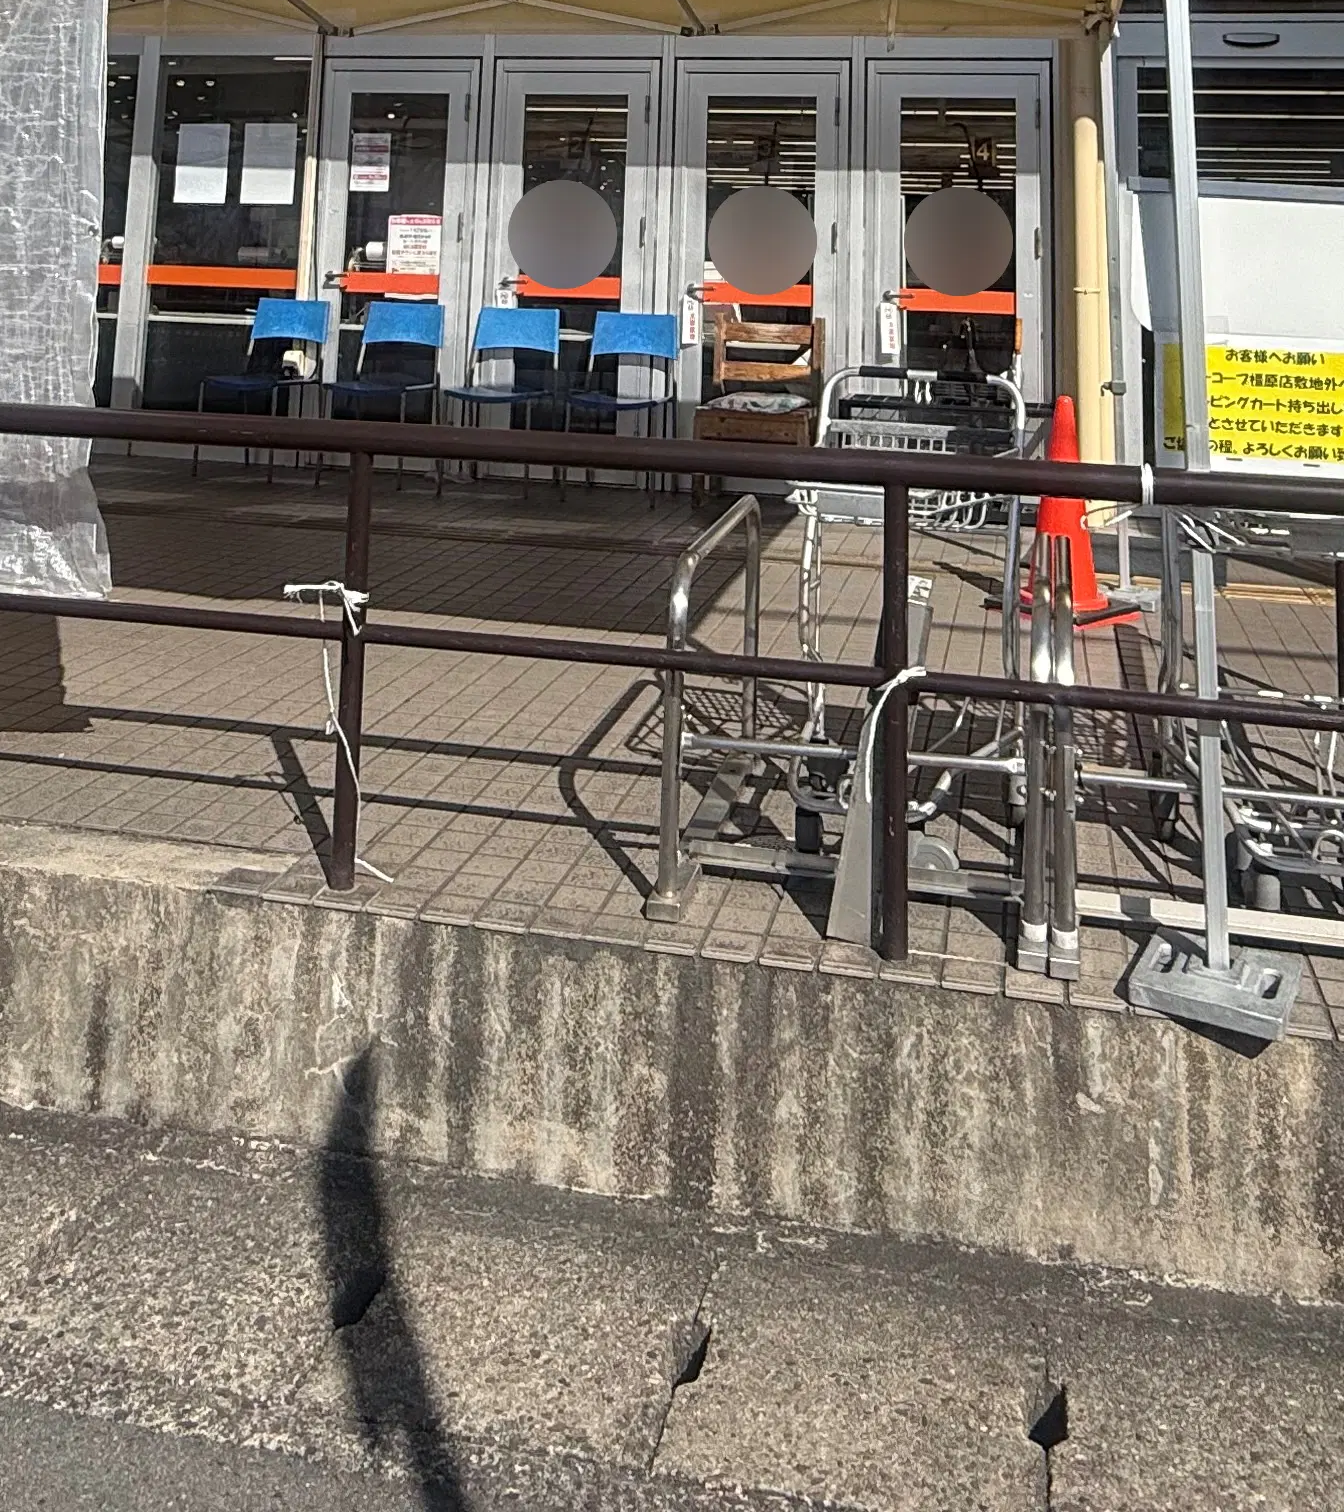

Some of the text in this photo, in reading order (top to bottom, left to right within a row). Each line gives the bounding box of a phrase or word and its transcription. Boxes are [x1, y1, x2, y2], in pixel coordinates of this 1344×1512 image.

[976, 142, 991, 161] 4
[1225, 348, 1325, 366] お客様へお願い
[1208, 417, 1344, 437] とさせていただきます
